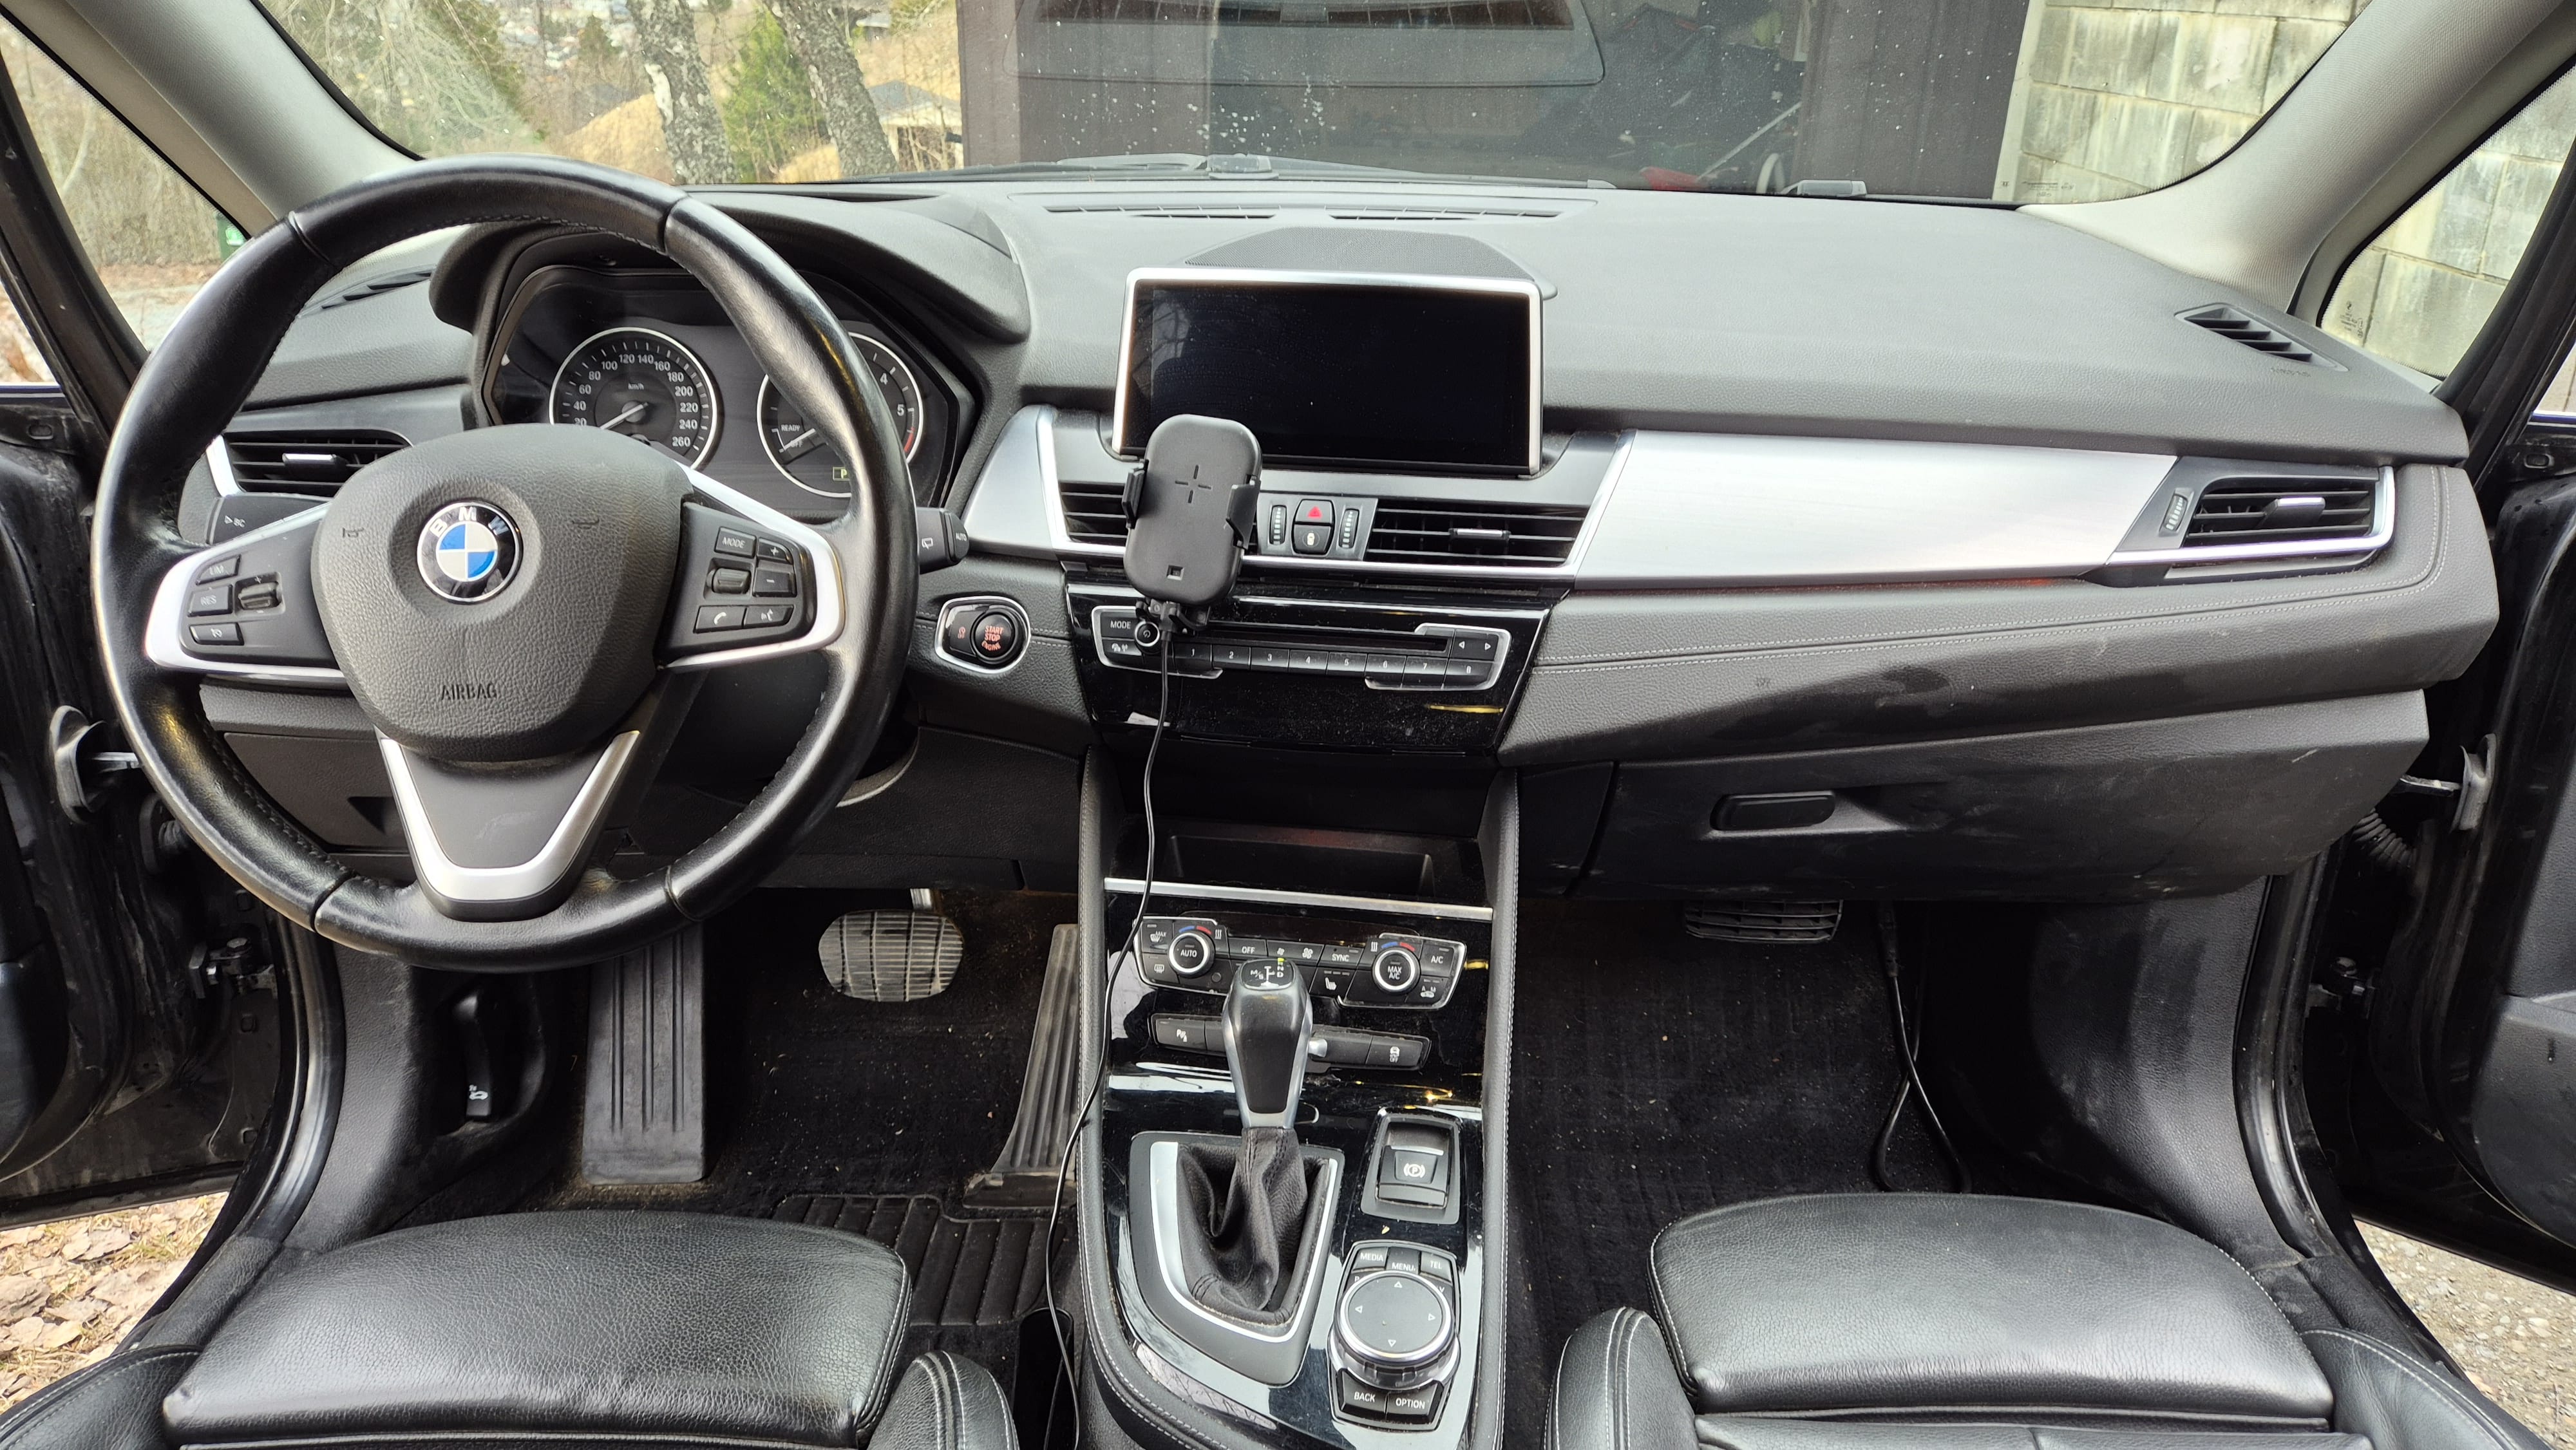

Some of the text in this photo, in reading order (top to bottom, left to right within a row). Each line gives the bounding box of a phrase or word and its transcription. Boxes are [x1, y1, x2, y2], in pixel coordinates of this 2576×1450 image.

[619, 354, 635, 364] 120
[638, 354, 654, 364] 140
[601, 361, 618, 370] 100
[654, 361, 671, 371] 160
[589, 371, 601, 381] 80
[667, 372, 685, 382] 180
[880, 373, 888, 385] 4
[579, 384, 592, 395] 60
[674, 386, 694, 397] 200
[573, 400, 587, 411] 40
[679, 402, 699, 413] 220
[896, 404, 905, 416] 5
[679, 419, 698, 429] 240
[672, 437, 691, 447] 260
[840, 468, 848, 479] P
[233, 518, 246, 527] BC
[430, 506, 509, 538] BMW
[955, 532, 967, 542] AUTO
[721, 536, 746, 549] MODE
[985, 625, 1004, 634] START
[1110, 620, 1132, 630] MODE
[984, 633, 1001, 642] STOP
[981, 641, 1001, 652] ENGINE
[441, 683, 497, 701] AIRBAG
[1242, 946, 1255, 954] OFF
[1332, 954, 1350, 962] SYNC
[1430, 956, 1443, 964] A/C
[1412, 1166, 1417, 1174] P
[1360, 1253, 1384, 1262] MEDIA
[1392, 1262, 1414, 1271] MENU
[1430, 1260, 1443, 1270] TEL
[1354, 1391, 1376, 1403] BACK
[1396, 1397, 1425, 1409] OPTION
